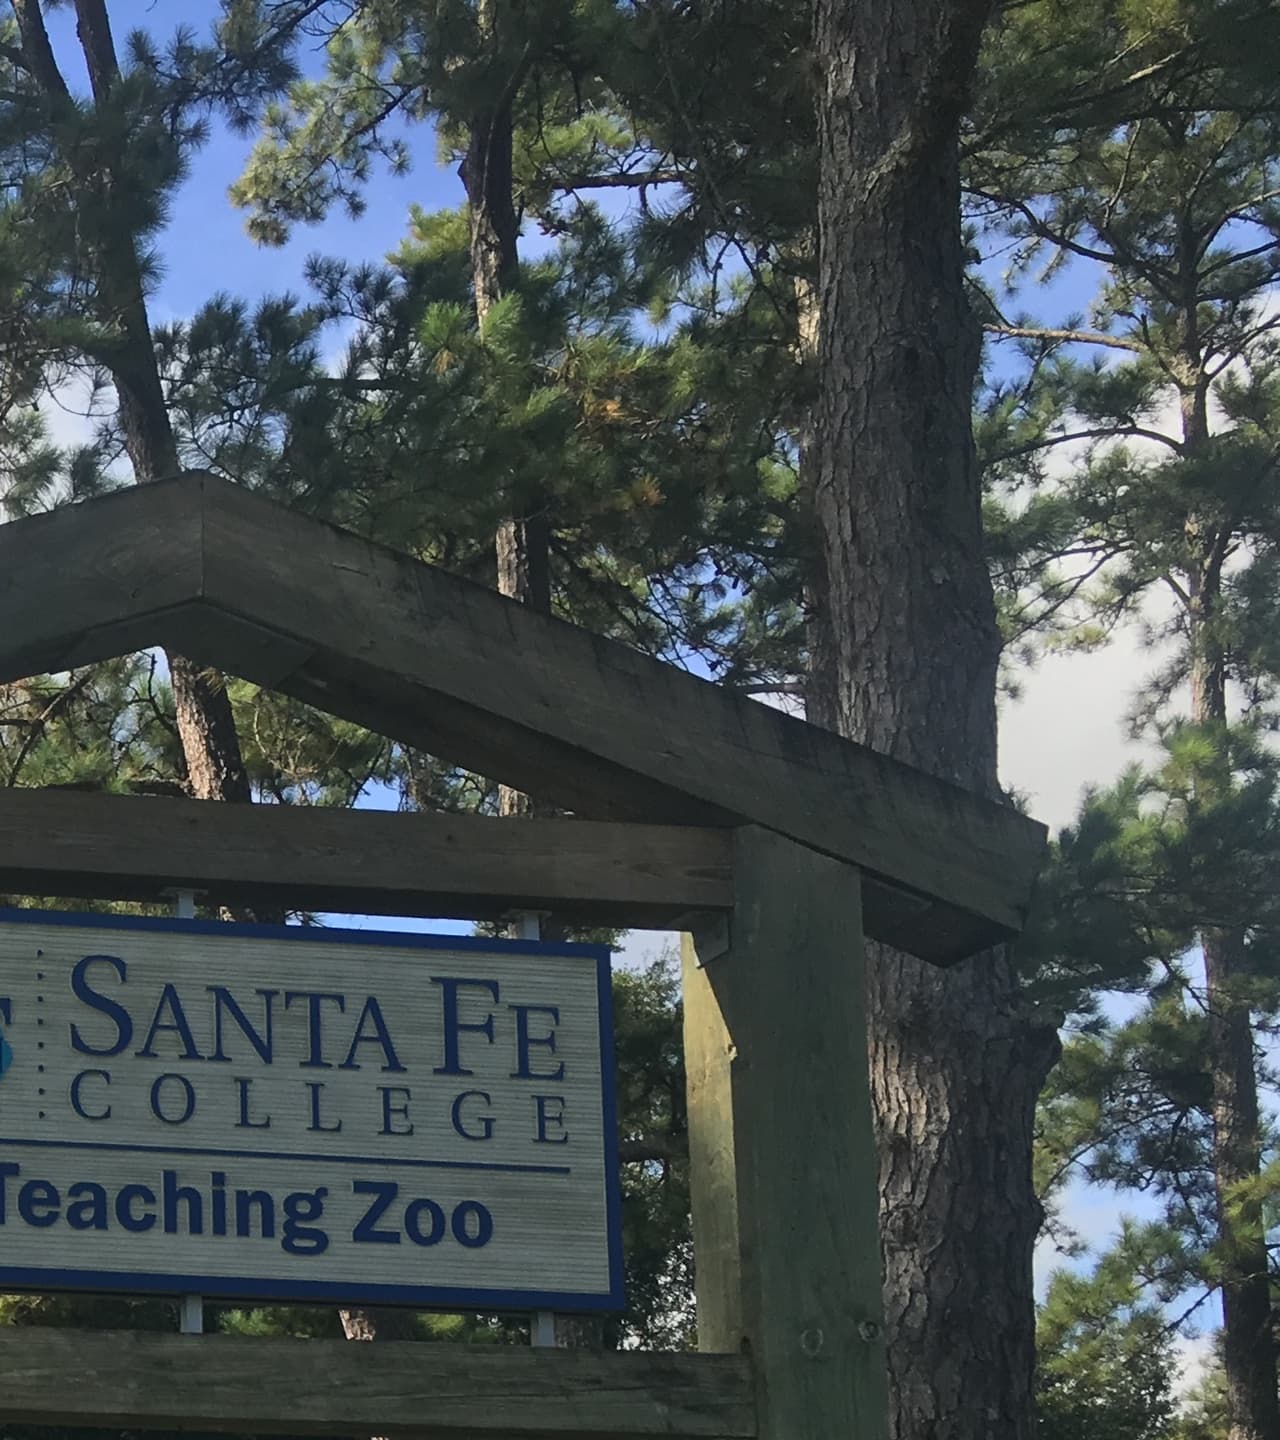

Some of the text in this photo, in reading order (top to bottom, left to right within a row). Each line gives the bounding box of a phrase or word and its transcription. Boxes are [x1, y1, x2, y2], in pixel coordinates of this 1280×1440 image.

[69, 954, 565, 1082] SANTA FE
[70, 1068, 569, 1144] COLLEGE
[352, 1180, 493, 1248] Zoo
